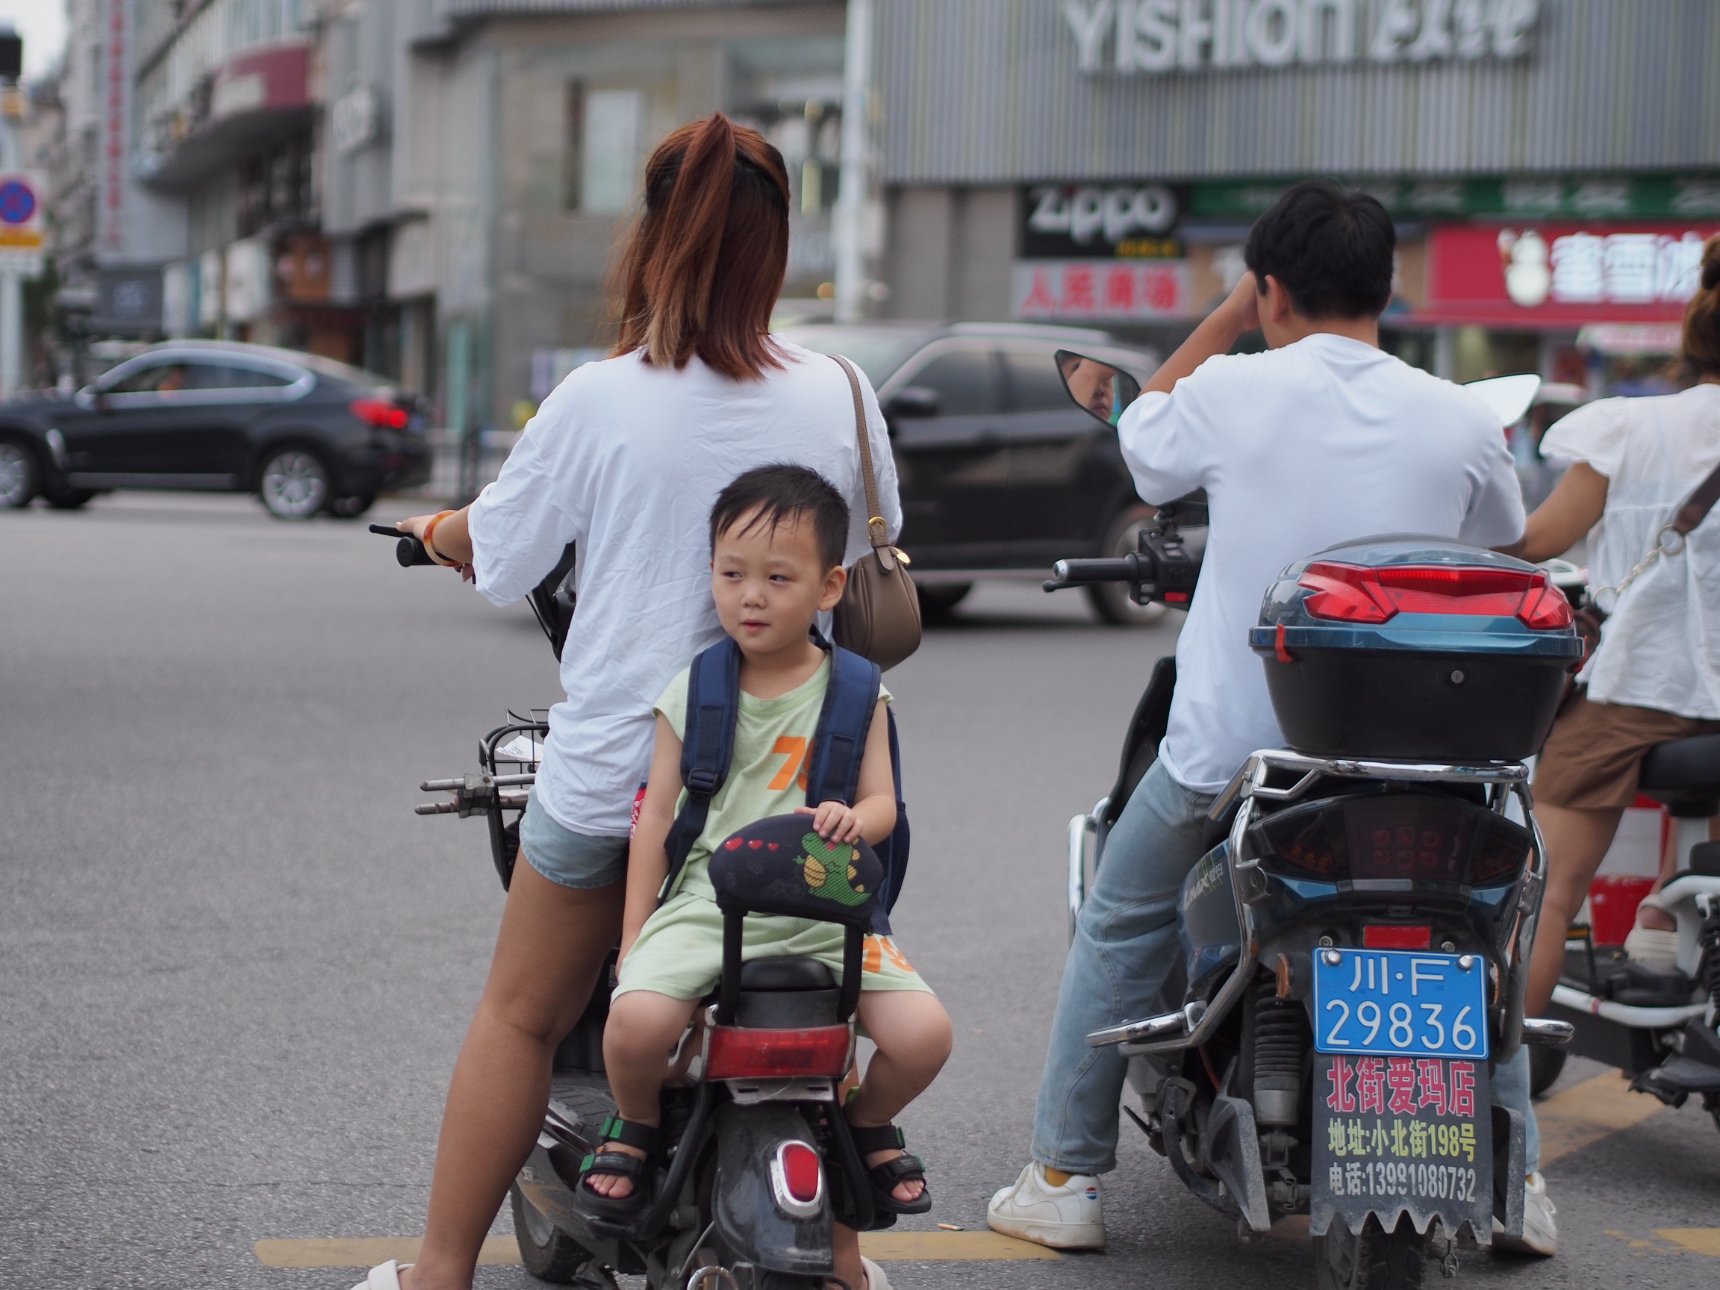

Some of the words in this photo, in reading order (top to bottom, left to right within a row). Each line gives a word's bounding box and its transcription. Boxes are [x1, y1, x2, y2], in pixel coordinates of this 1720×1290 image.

[1326, 999, 1476, 1050] 29836
[1326, 1056, 1475, 1117] 北街爱玛店
